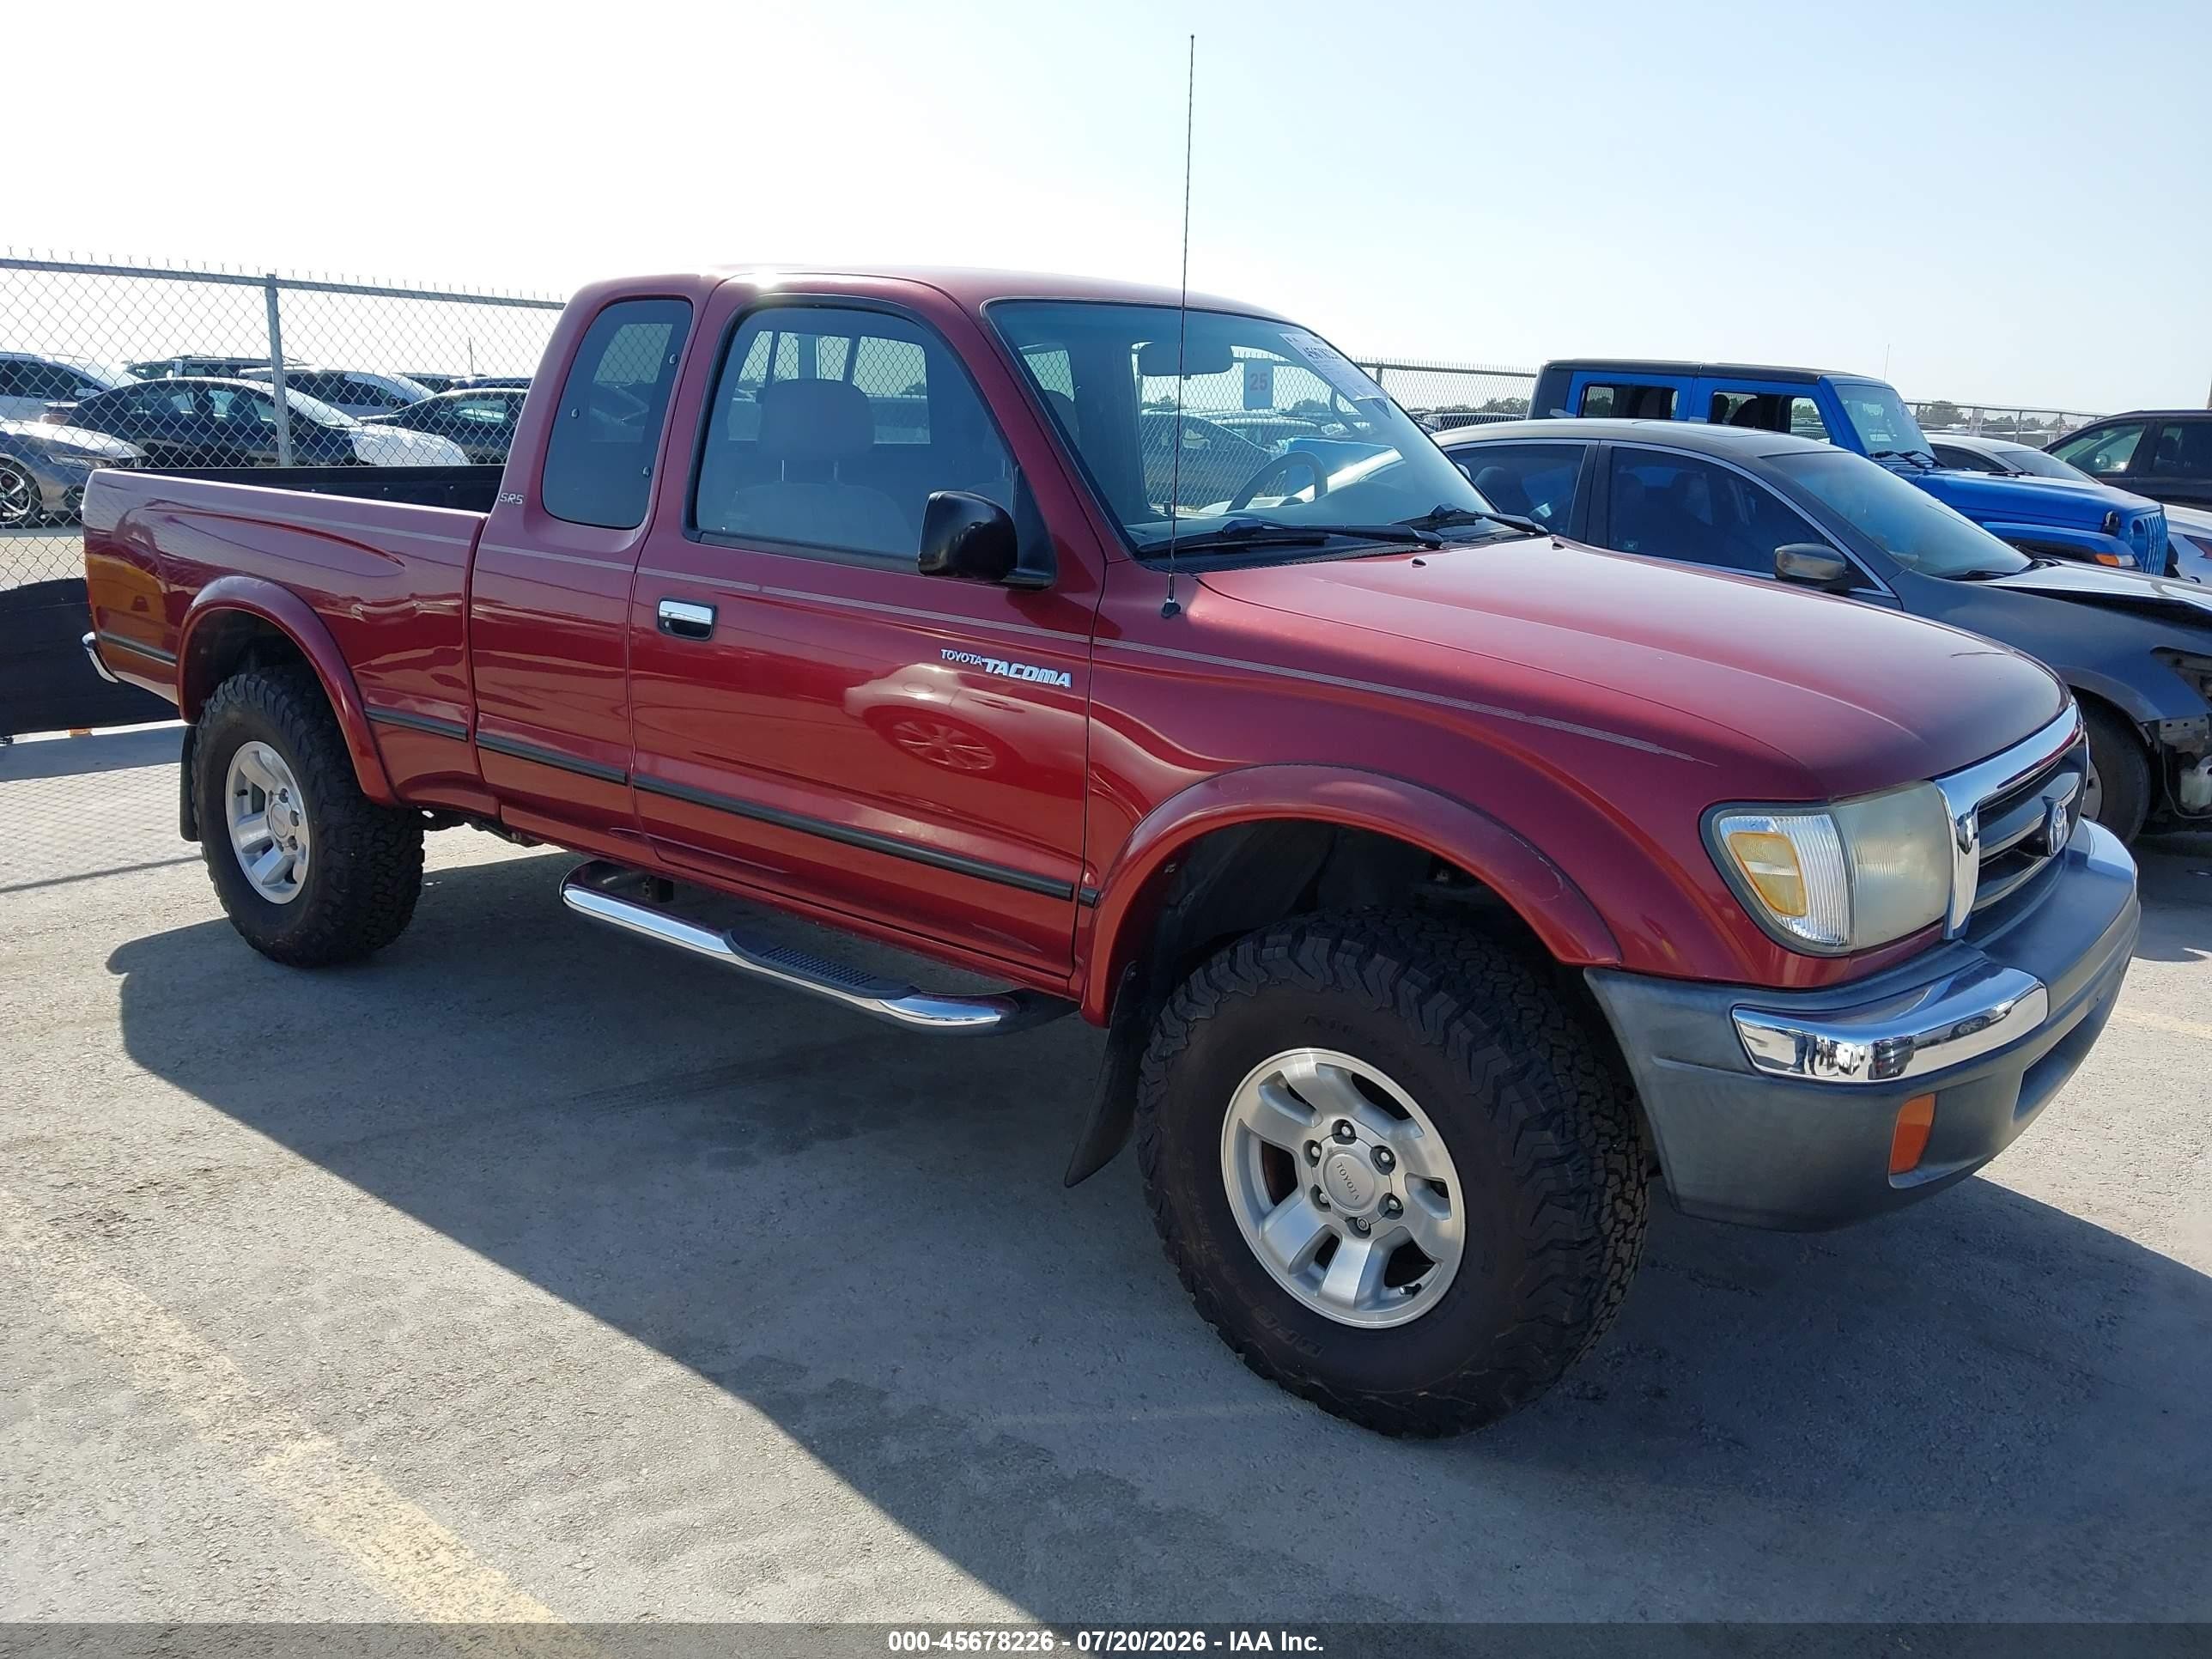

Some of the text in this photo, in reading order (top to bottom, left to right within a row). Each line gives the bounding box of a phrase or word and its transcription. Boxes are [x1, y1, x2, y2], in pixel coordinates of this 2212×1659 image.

[1249, 373, 1268, 391] 25
[499, 492, 525, 505] SR5
[940, 648, 1072, 688] TOYOTA TACOMA
[1335, 1162, 1360, 1200] TOYOTA
